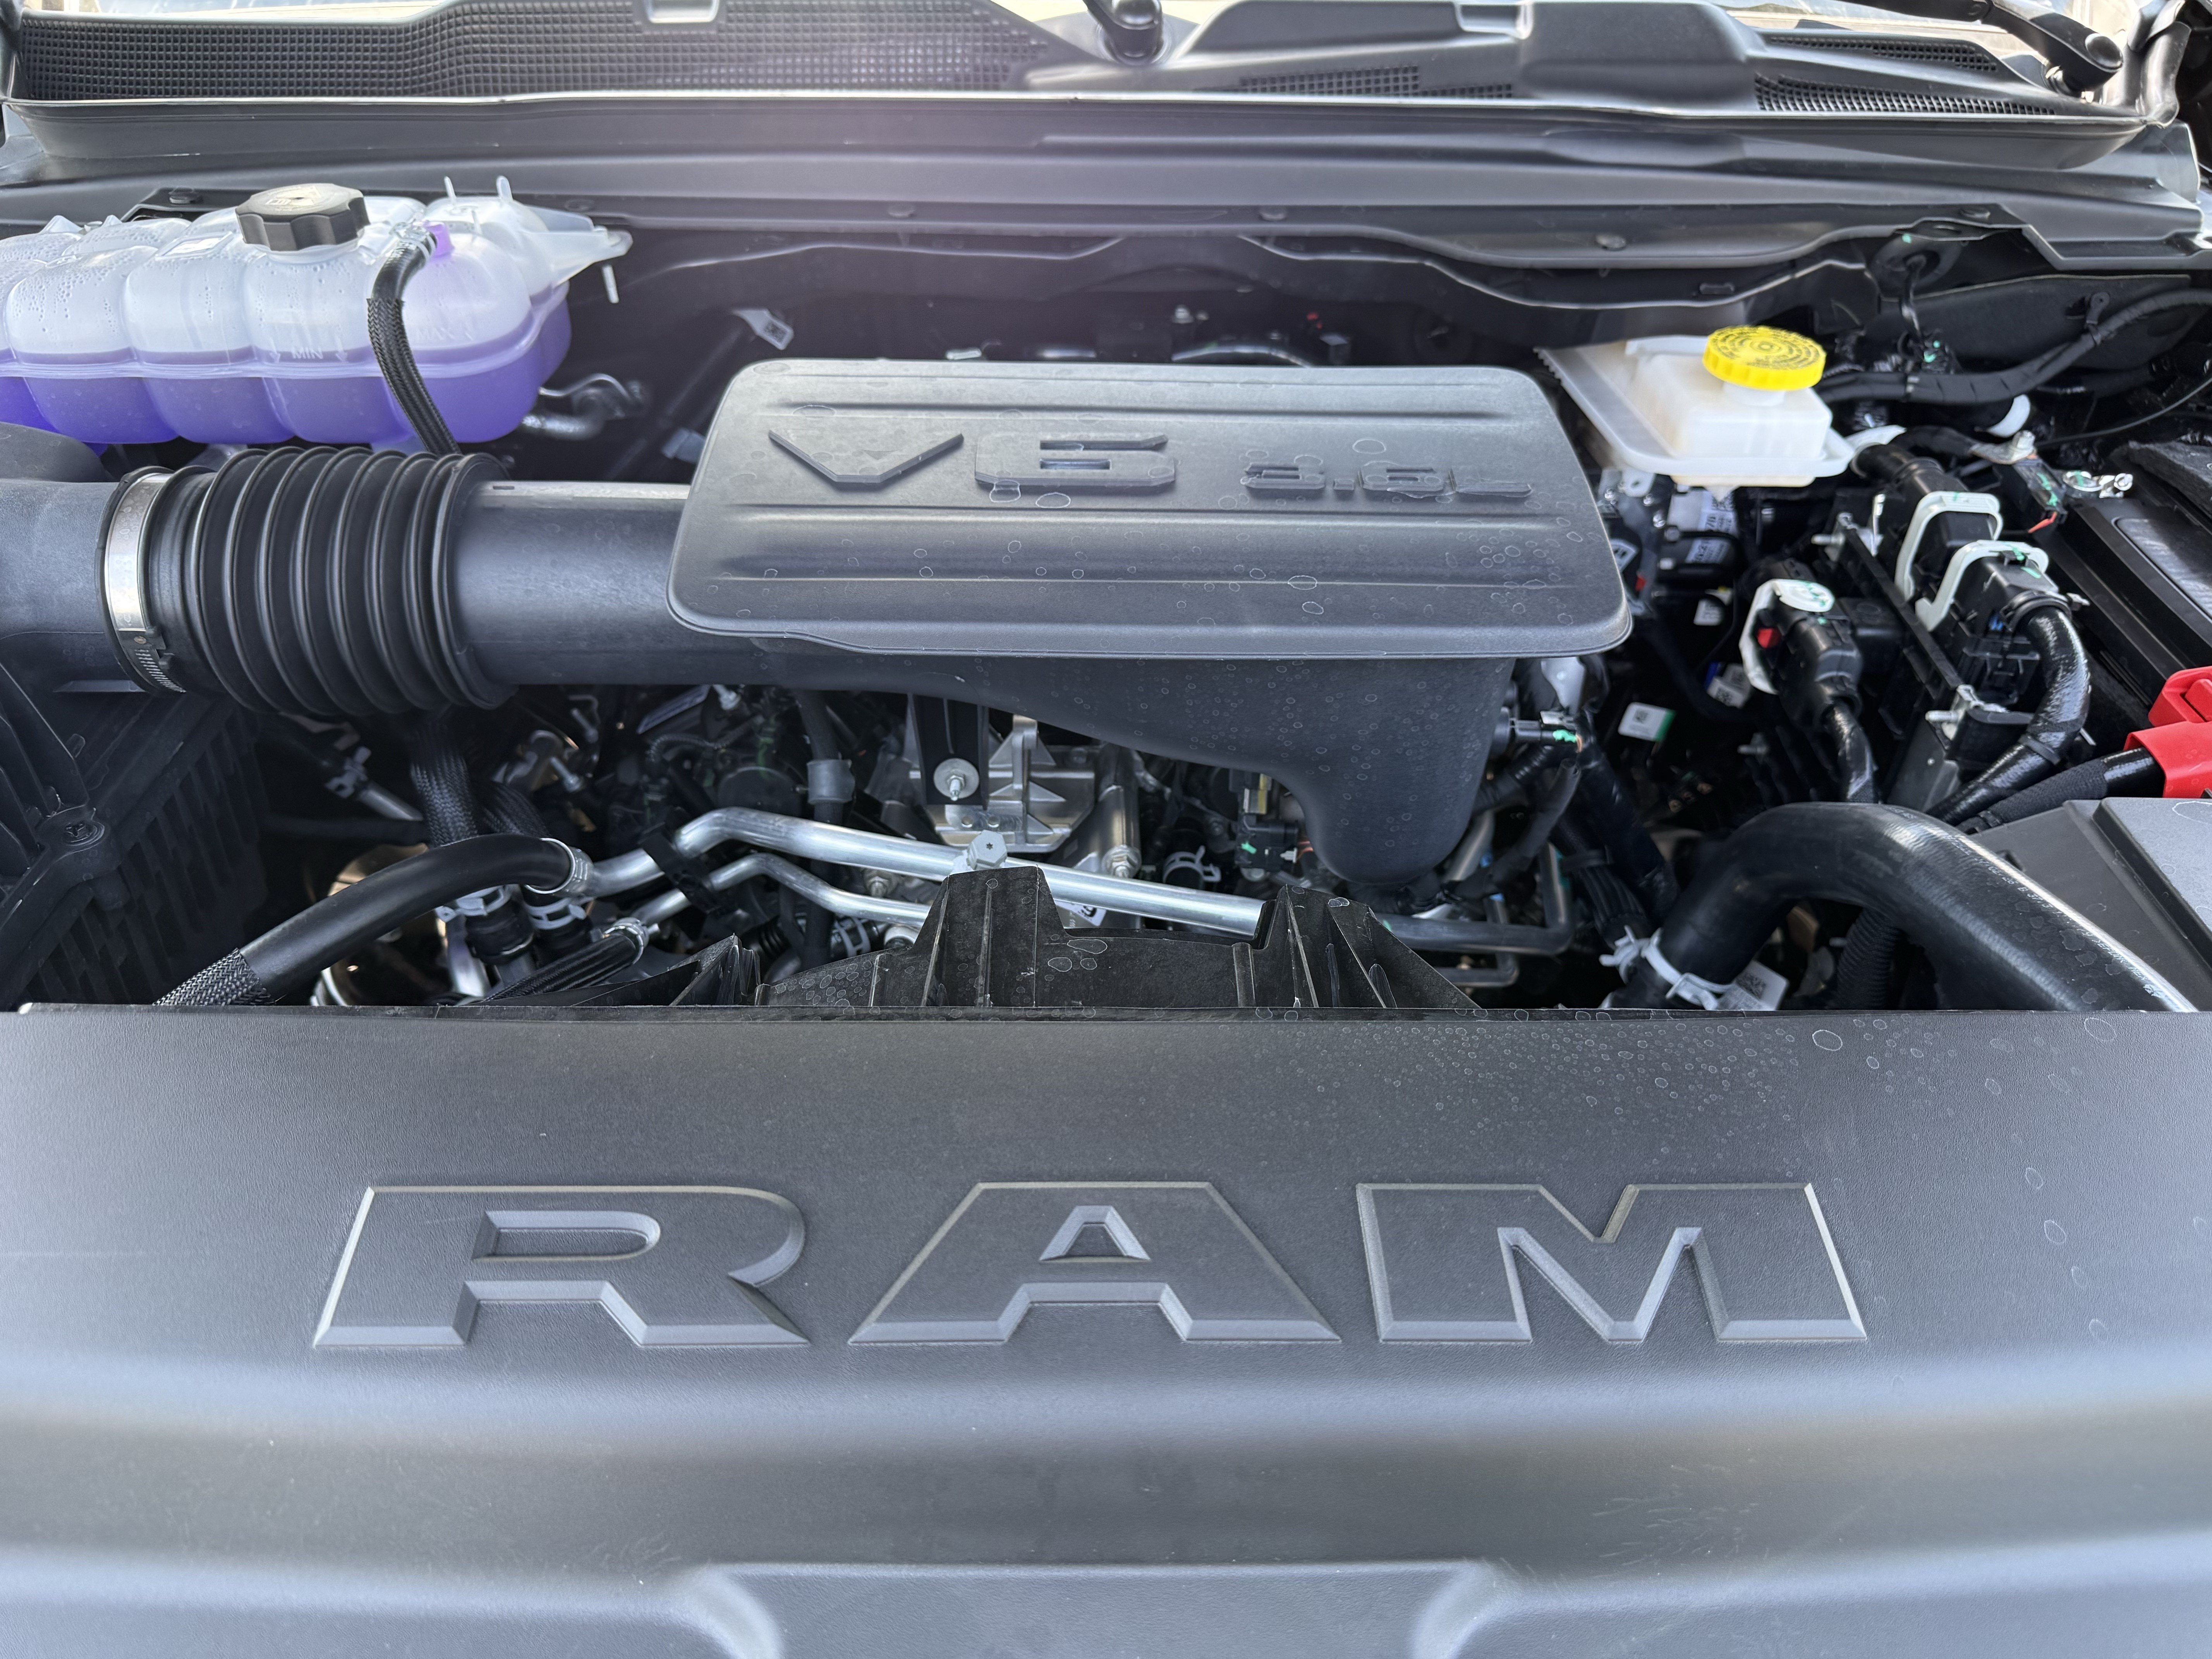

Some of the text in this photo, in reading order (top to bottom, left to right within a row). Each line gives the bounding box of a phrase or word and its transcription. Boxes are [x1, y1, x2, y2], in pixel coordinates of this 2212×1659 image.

[292, 347, 323, 359] MIN
[768, 429, 1533, 498] V6 3.6L
[311, 1182, 1867, 1348] RAM
